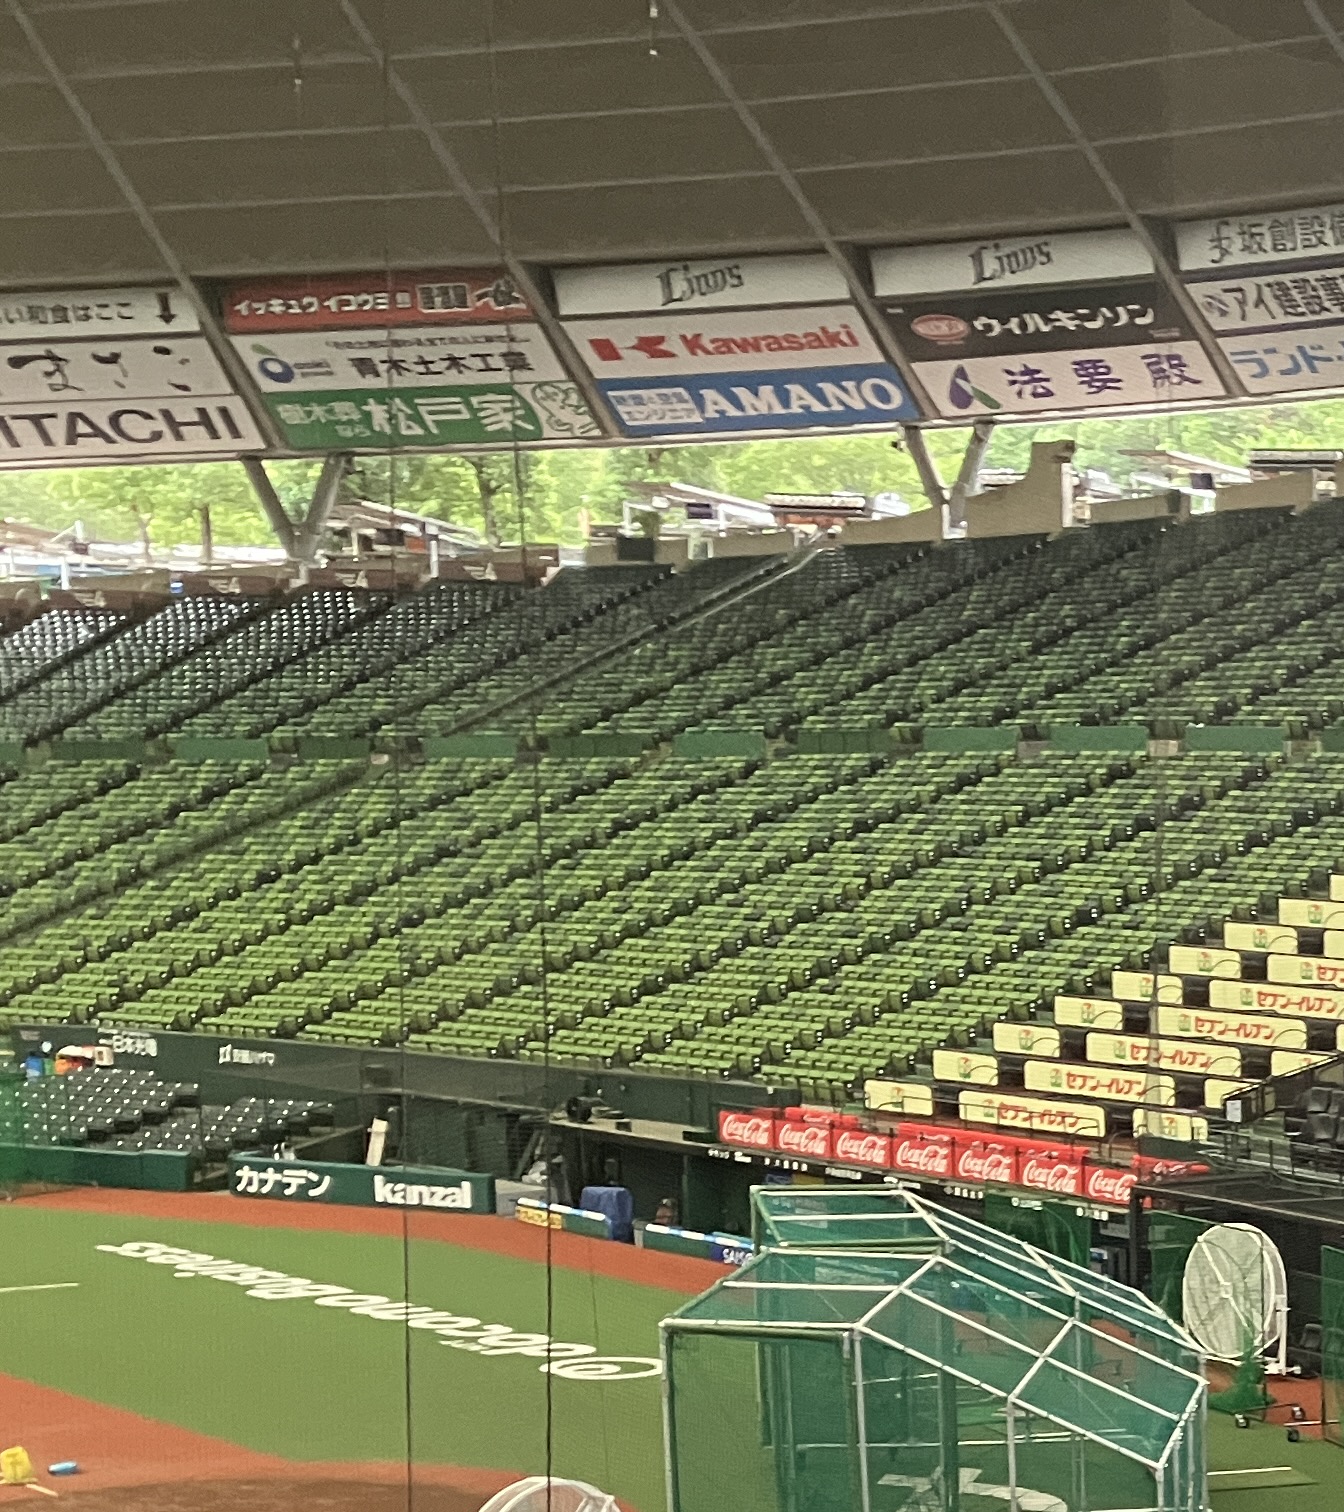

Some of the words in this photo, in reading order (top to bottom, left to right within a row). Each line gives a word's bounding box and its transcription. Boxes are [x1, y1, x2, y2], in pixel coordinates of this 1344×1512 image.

[973, 304, 1154, 336] ウィルキンソン
[679, 324, 860, 357] Kawasaki
[700, 378, 903, 418] AMANO
[236, 1165, 331, 1197] カナデン
